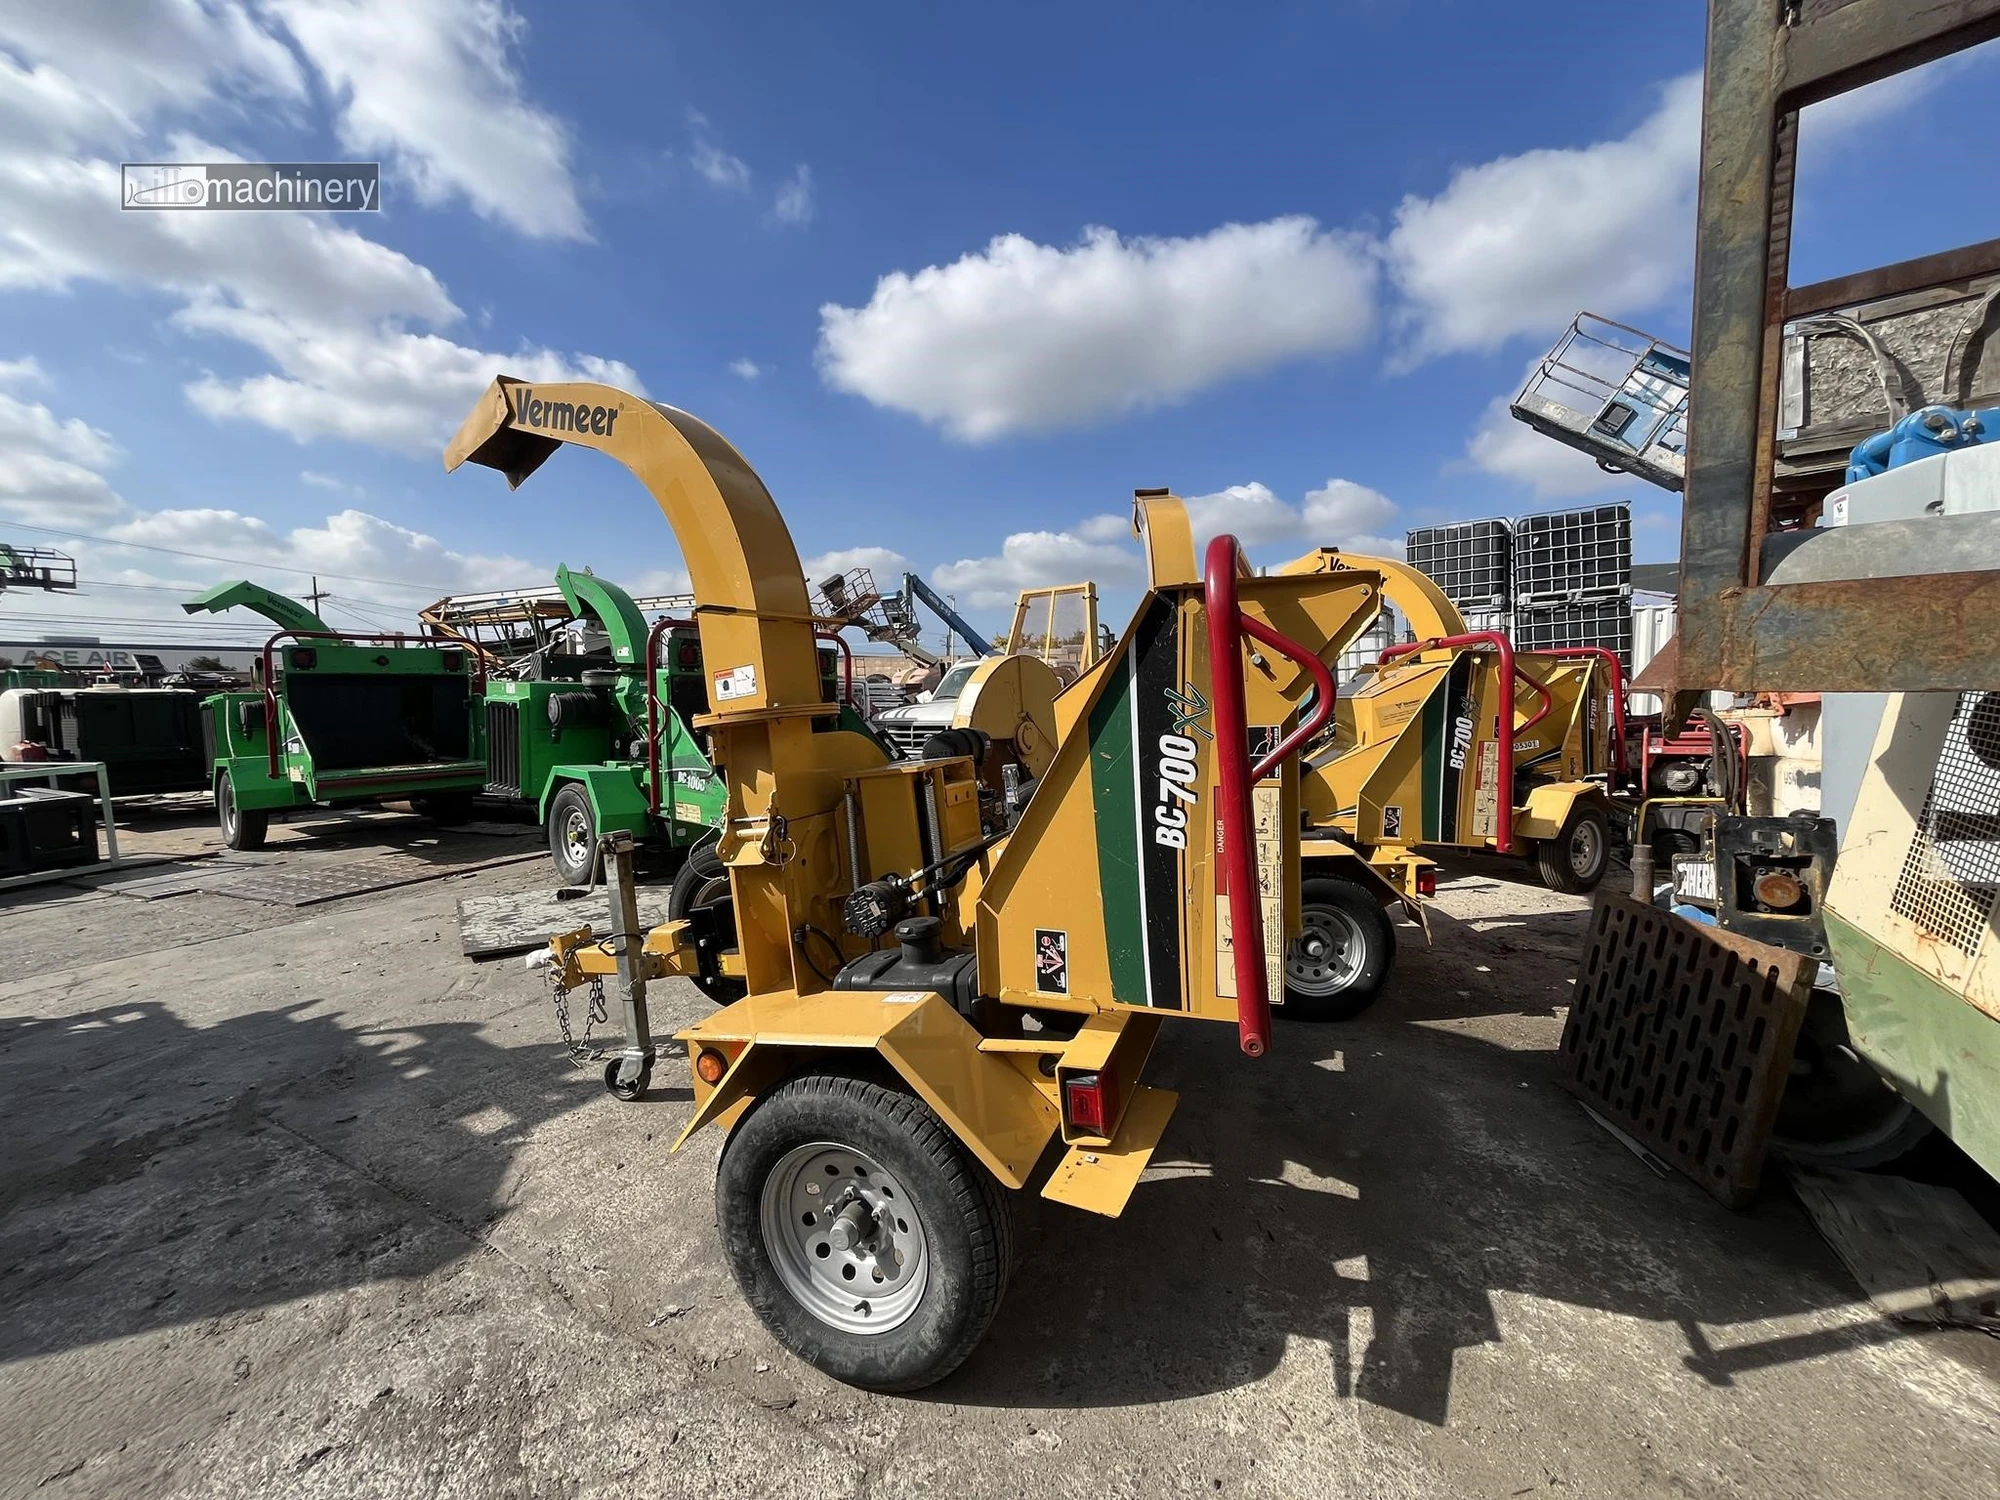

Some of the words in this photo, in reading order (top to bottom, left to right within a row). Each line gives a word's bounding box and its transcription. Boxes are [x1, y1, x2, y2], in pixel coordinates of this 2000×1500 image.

[515, 388, 618, 437] Vermeer
[22, 650, 79, 664] ACE
[87, 651, 129, 665] AIR
[1217, 819, 1225, 854] DANGER
